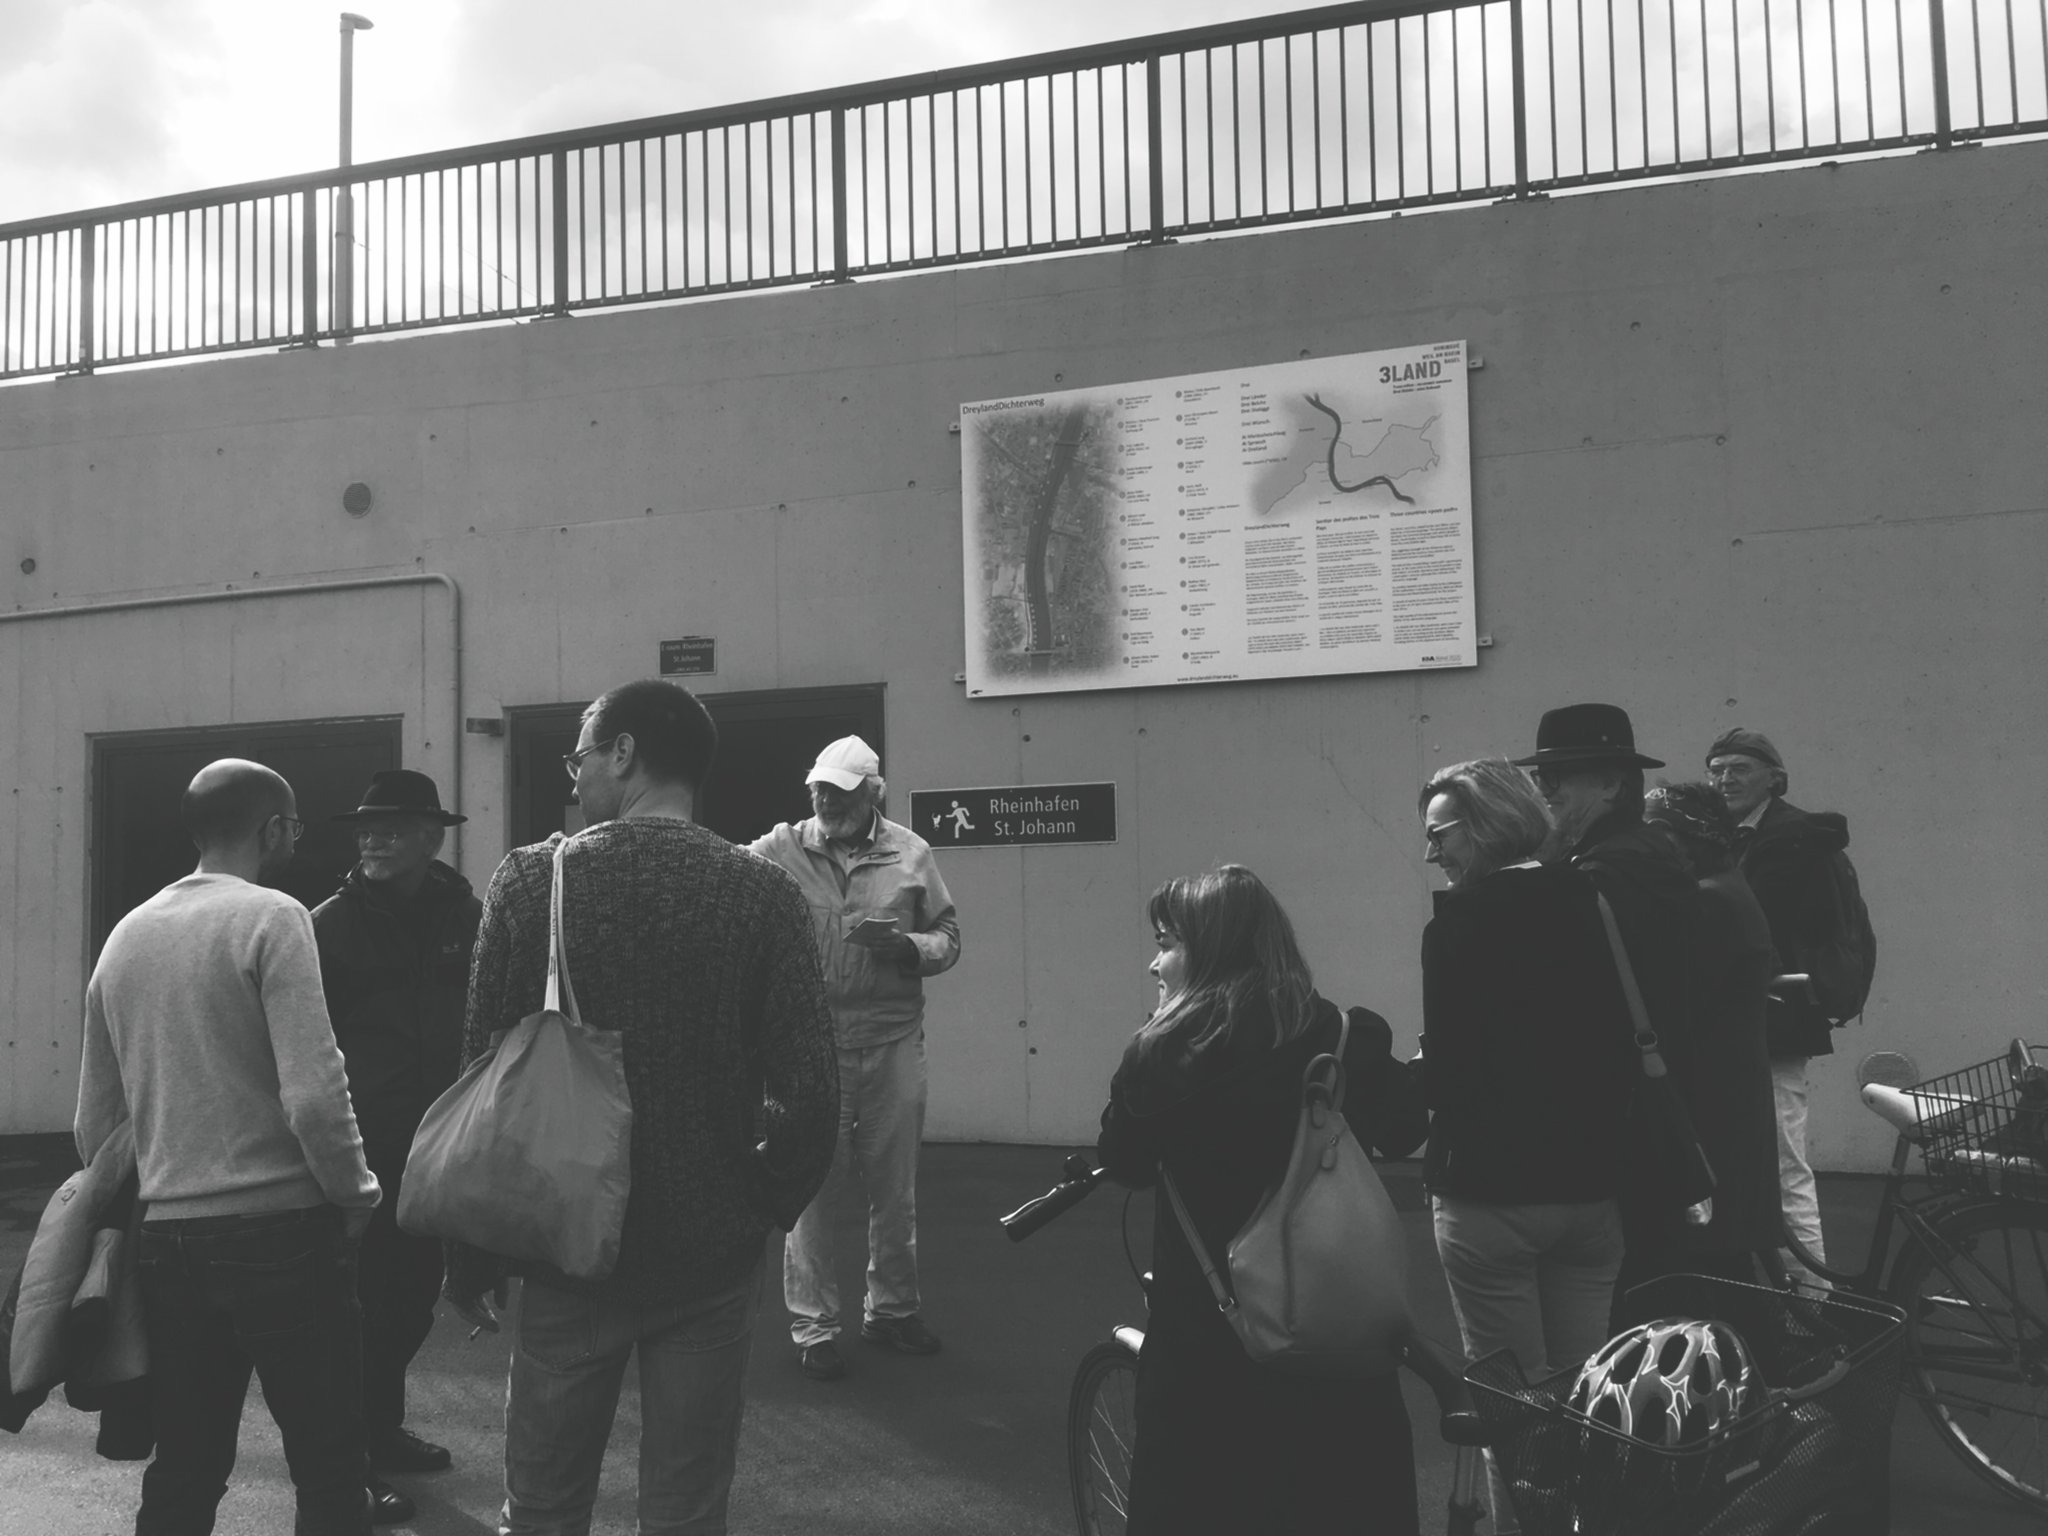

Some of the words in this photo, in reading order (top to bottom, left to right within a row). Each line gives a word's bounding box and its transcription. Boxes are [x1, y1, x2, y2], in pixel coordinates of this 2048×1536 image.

[1379, 361, 1442, 384] 3LAND
[963, 398, 1045, 415] DreylandDichterweg
[990, 795, 1080, 815] Rheinhafen
[994, 820, 1015, 837] St.
[1019, 818, 1076, 836] Johann
